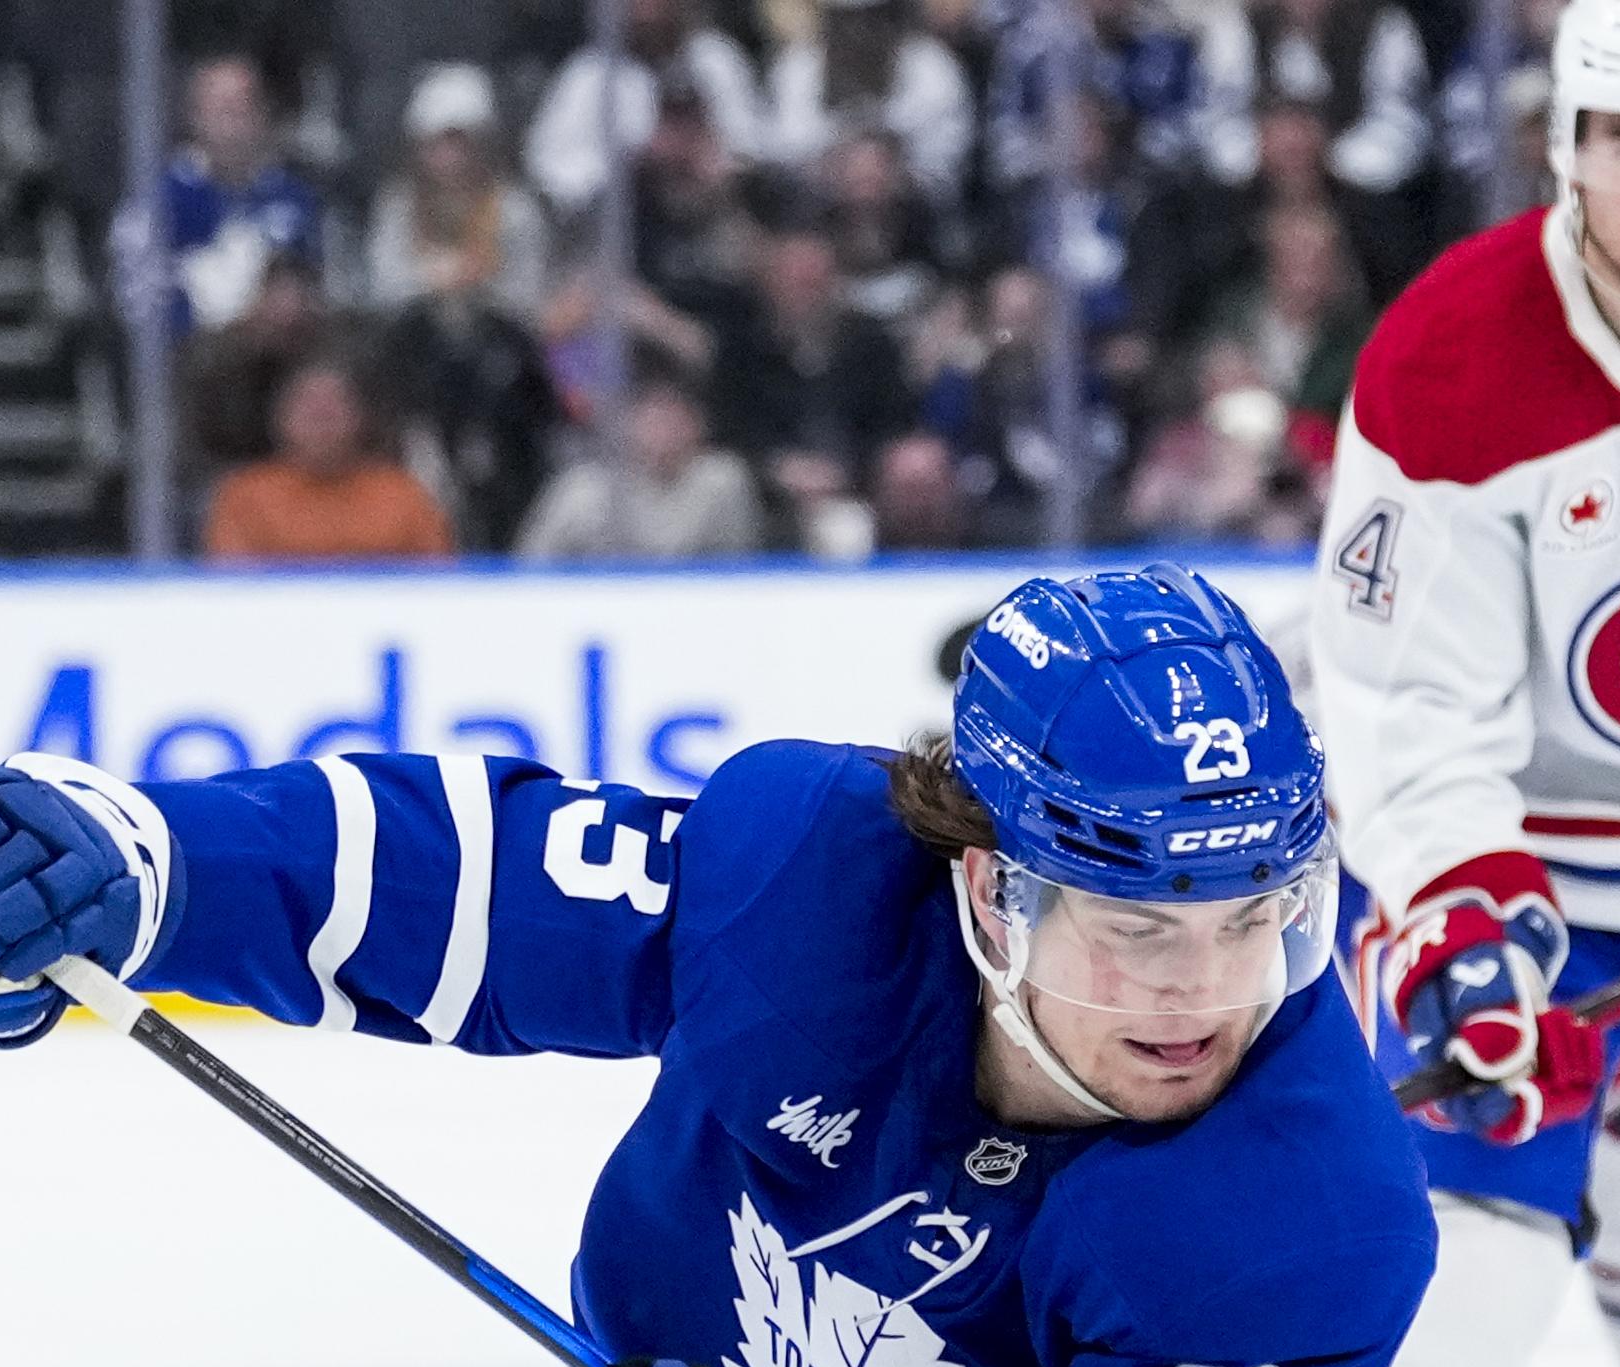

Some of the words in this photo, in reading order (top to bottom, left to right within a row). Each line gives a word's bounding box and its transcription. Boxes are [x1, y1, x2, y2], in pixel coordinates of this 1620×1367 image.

[1173, 717, 1251, 784] 23
[543, 778, 684, 916] 3
[1166, 819, 1279, 854] CCM
